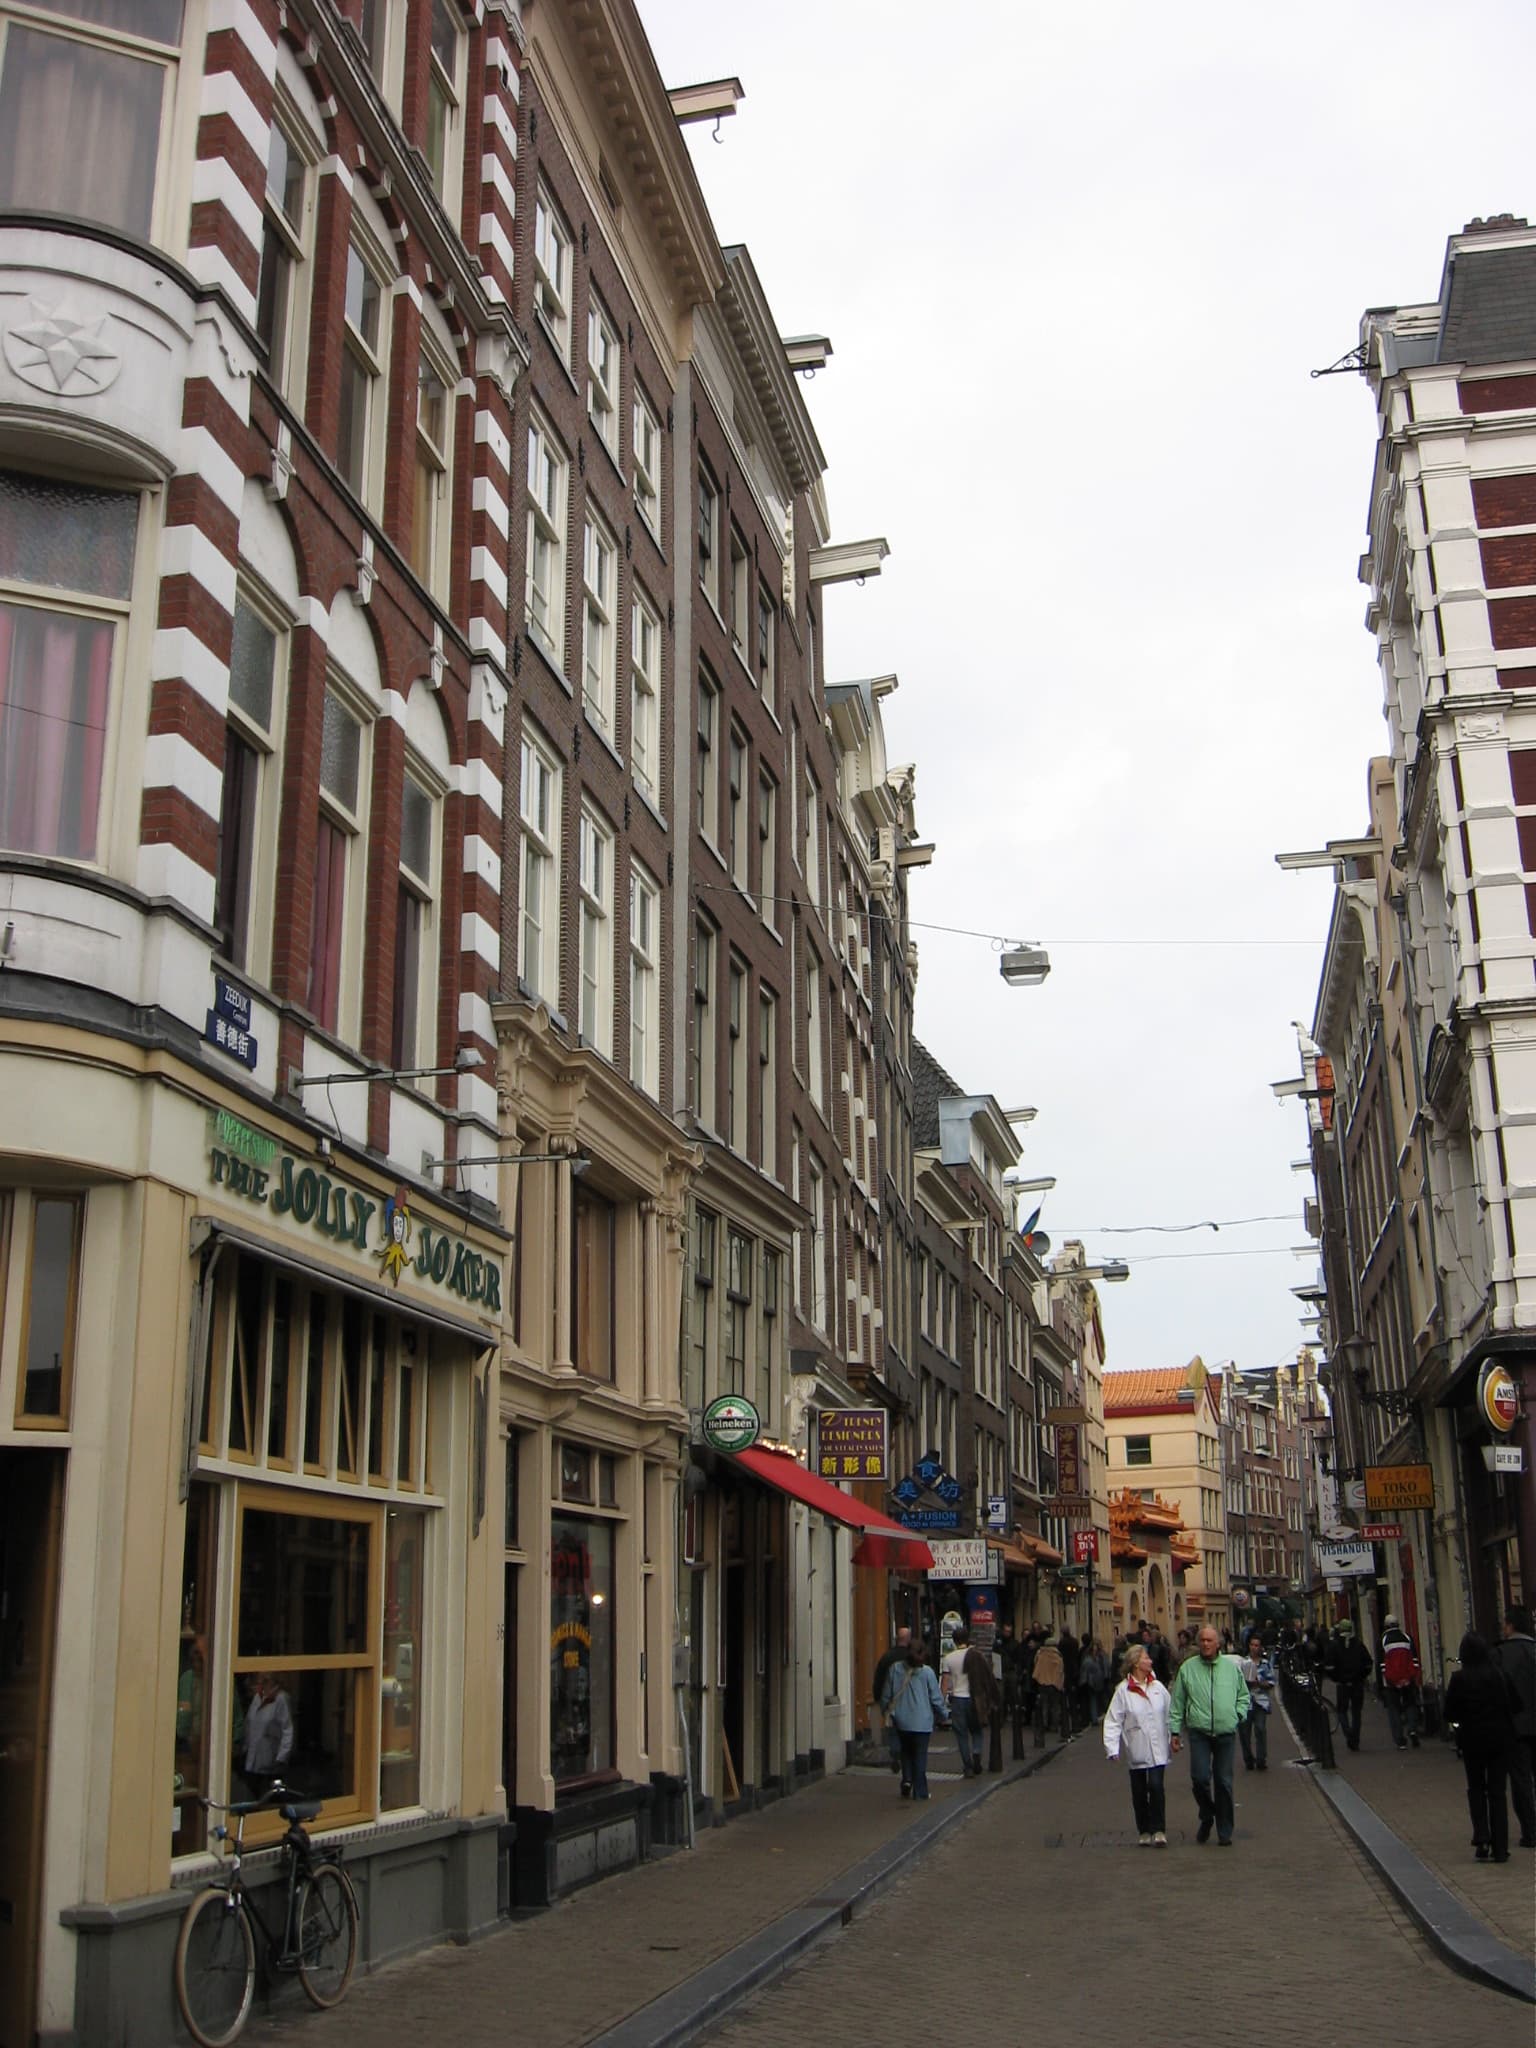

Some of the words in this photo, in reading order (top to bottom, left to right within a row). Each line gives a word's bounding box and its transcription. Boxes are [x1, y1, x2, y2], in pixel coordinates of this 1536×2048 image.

[211, 1147, 269, 1203] THE
[273, 1156, 376, 1249] JOLLY
[414, 1227, 501, 1312] JOKER
[708, 1418, 753, 1429] Heineken
[1381, 1481, 1417, 1494] TOKO
[918, 1511, 957, 1521] FUSION
[1321, 1543, 1372, 1556] VISHANDEL
[950, 1555, 984, 1569] QUANG
[932, 1568, 982, 1578] JUWELIER
